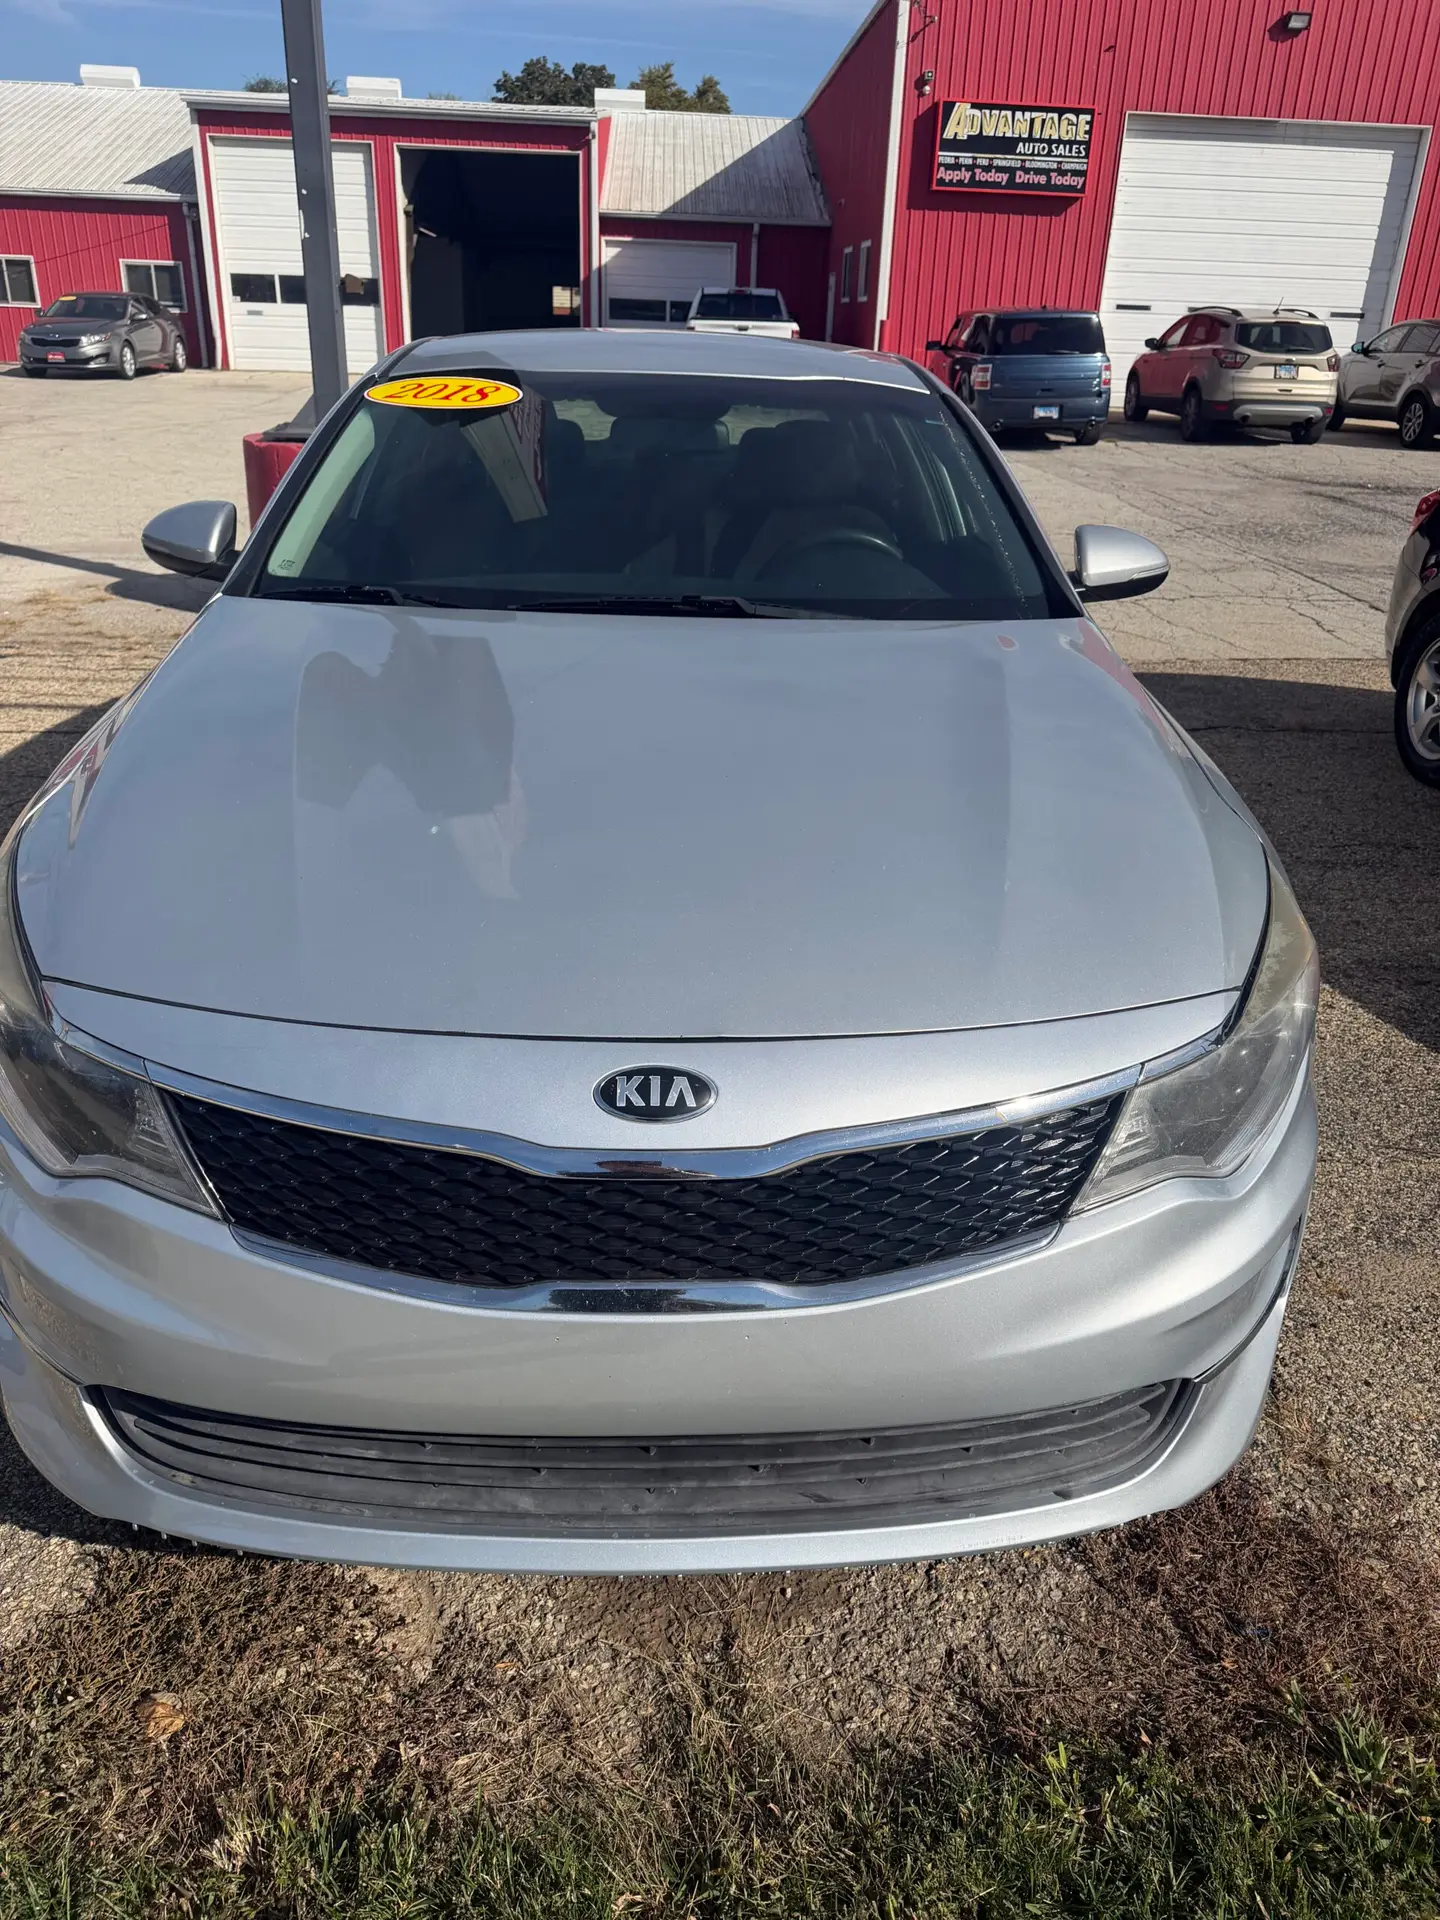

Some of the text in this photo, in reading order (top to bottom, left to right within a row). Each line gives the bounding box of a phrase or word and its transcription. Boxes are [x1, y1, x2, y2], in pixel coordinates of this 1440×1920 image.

[942, 102, 1092, 140] ADVANTAGE
[1016, 142, 1086, 157] AUTO SALES
[976, 158, 989, 166] PERU
[992, 159, 1021, 167] SPRINGFIELD
[1025, 161, 1057, 169] BLOOMINGTON
[1061, 162, 1087, 171] CHAMPAIGN
[937, 166, 1085, 189] Apply Today Drive Today
[383, 382, 501, 403] 2018
[615, 1075, 697, 1108] KIA
